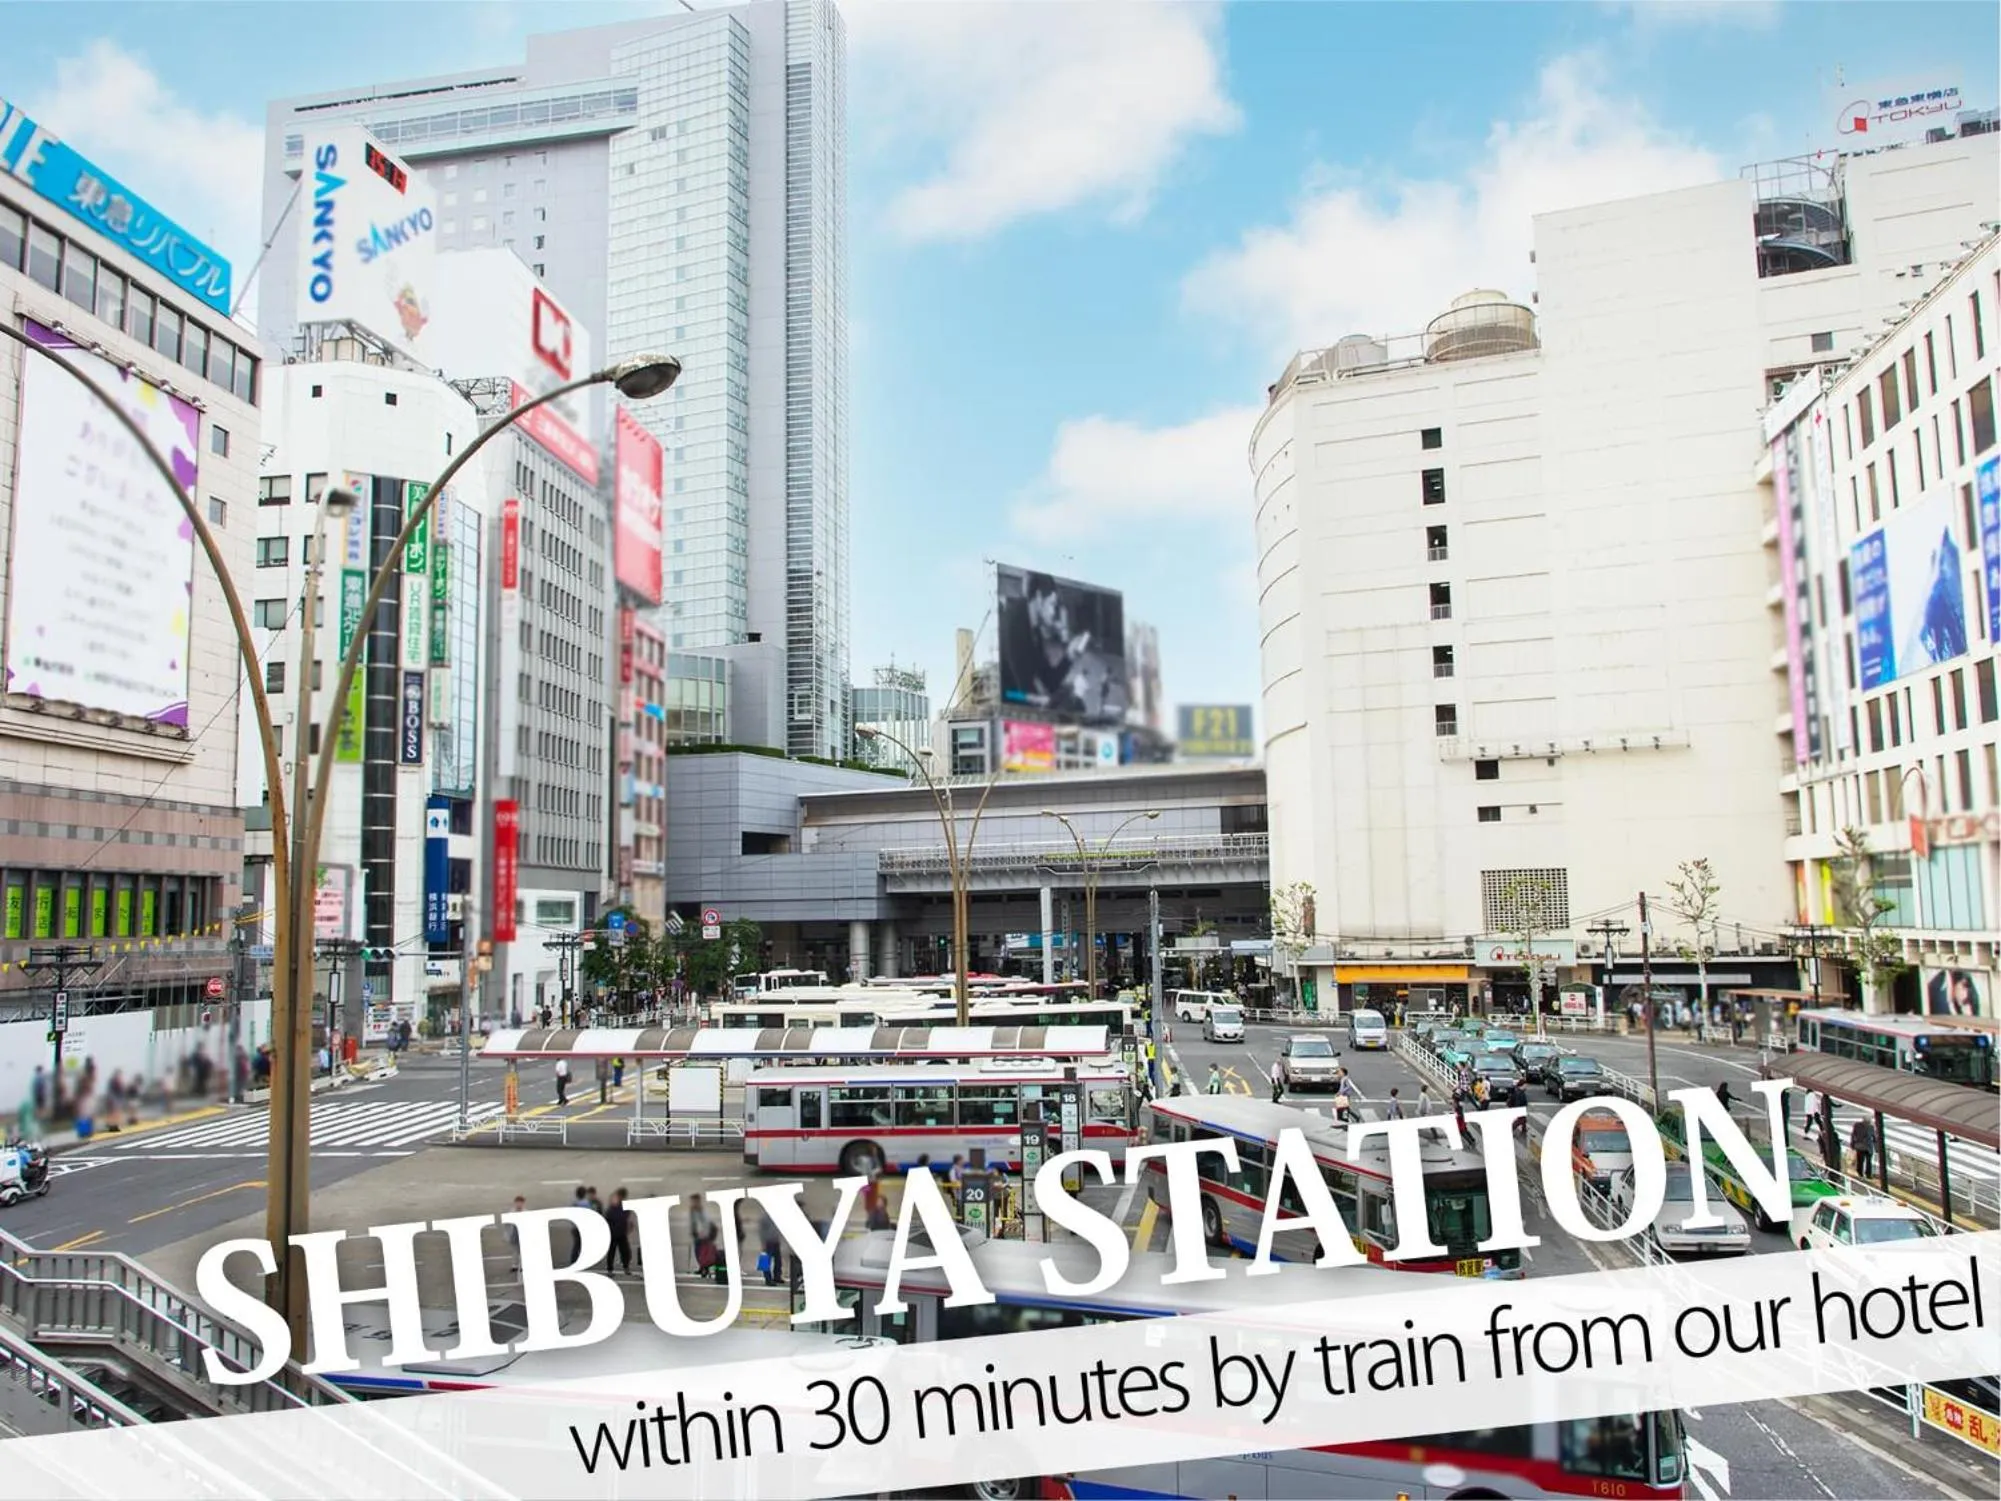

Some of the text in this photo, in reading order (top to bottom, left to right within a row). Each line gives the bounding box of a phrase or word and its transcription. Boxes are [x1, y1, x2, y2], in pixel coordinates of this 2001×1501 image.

[1870, 99, 1962, 124] TOKYU
[309, 143, 347, 303] SANKYO
[356, 206, 433, 264] SANKYO
[406, 701, 420, 759] BOSS
[1124, 1043, 1135, 1052] 17
[1062, 1093, 1076, 1103] 18
[1024, 1134, 1040, 1145] 19
[965, 1188, 984, 1201] 20
